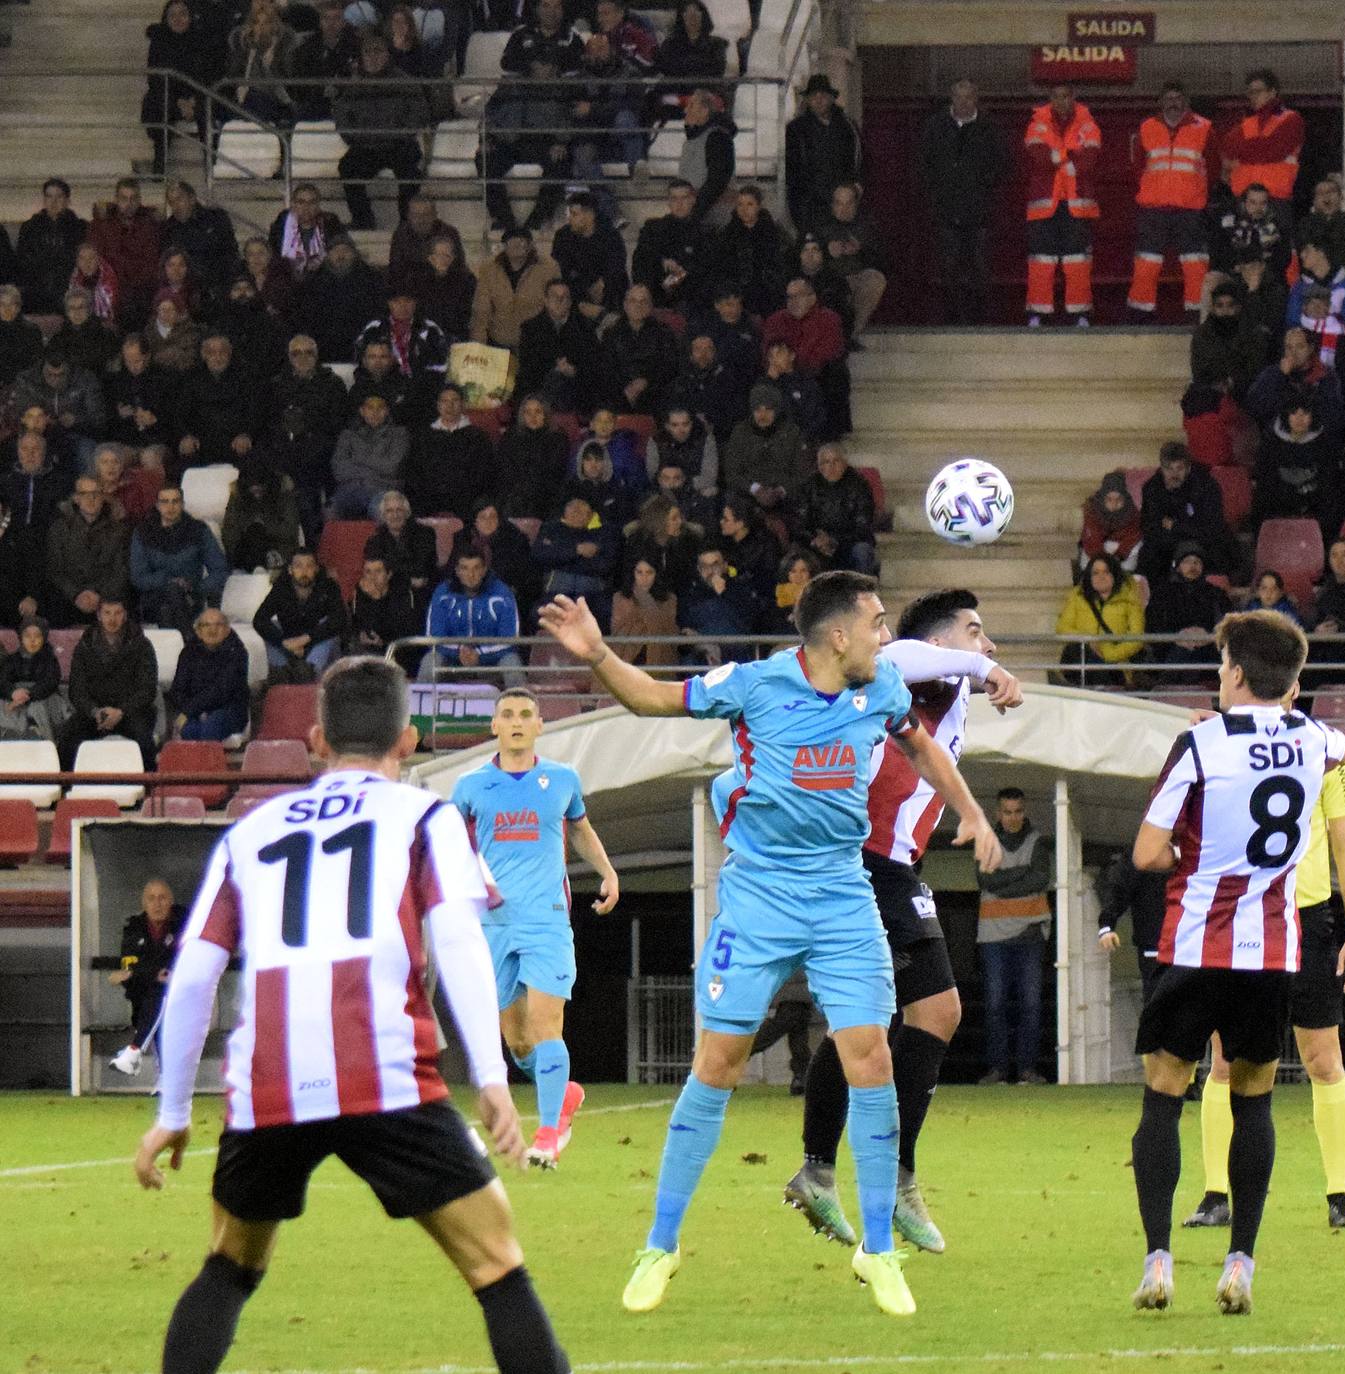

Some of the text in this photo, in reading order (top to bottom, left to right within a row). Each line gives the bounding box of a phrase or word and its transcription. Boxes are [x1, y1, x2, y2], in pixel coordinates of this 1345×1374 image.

[1075, 20, 1147, 36] SALIDA
[1041, 46, 1125, 62] SALIDA
[1246, 774, 1306, 869] 8
[258, 820, 376, 947] 11
[712, 930, 736, 971] 5
